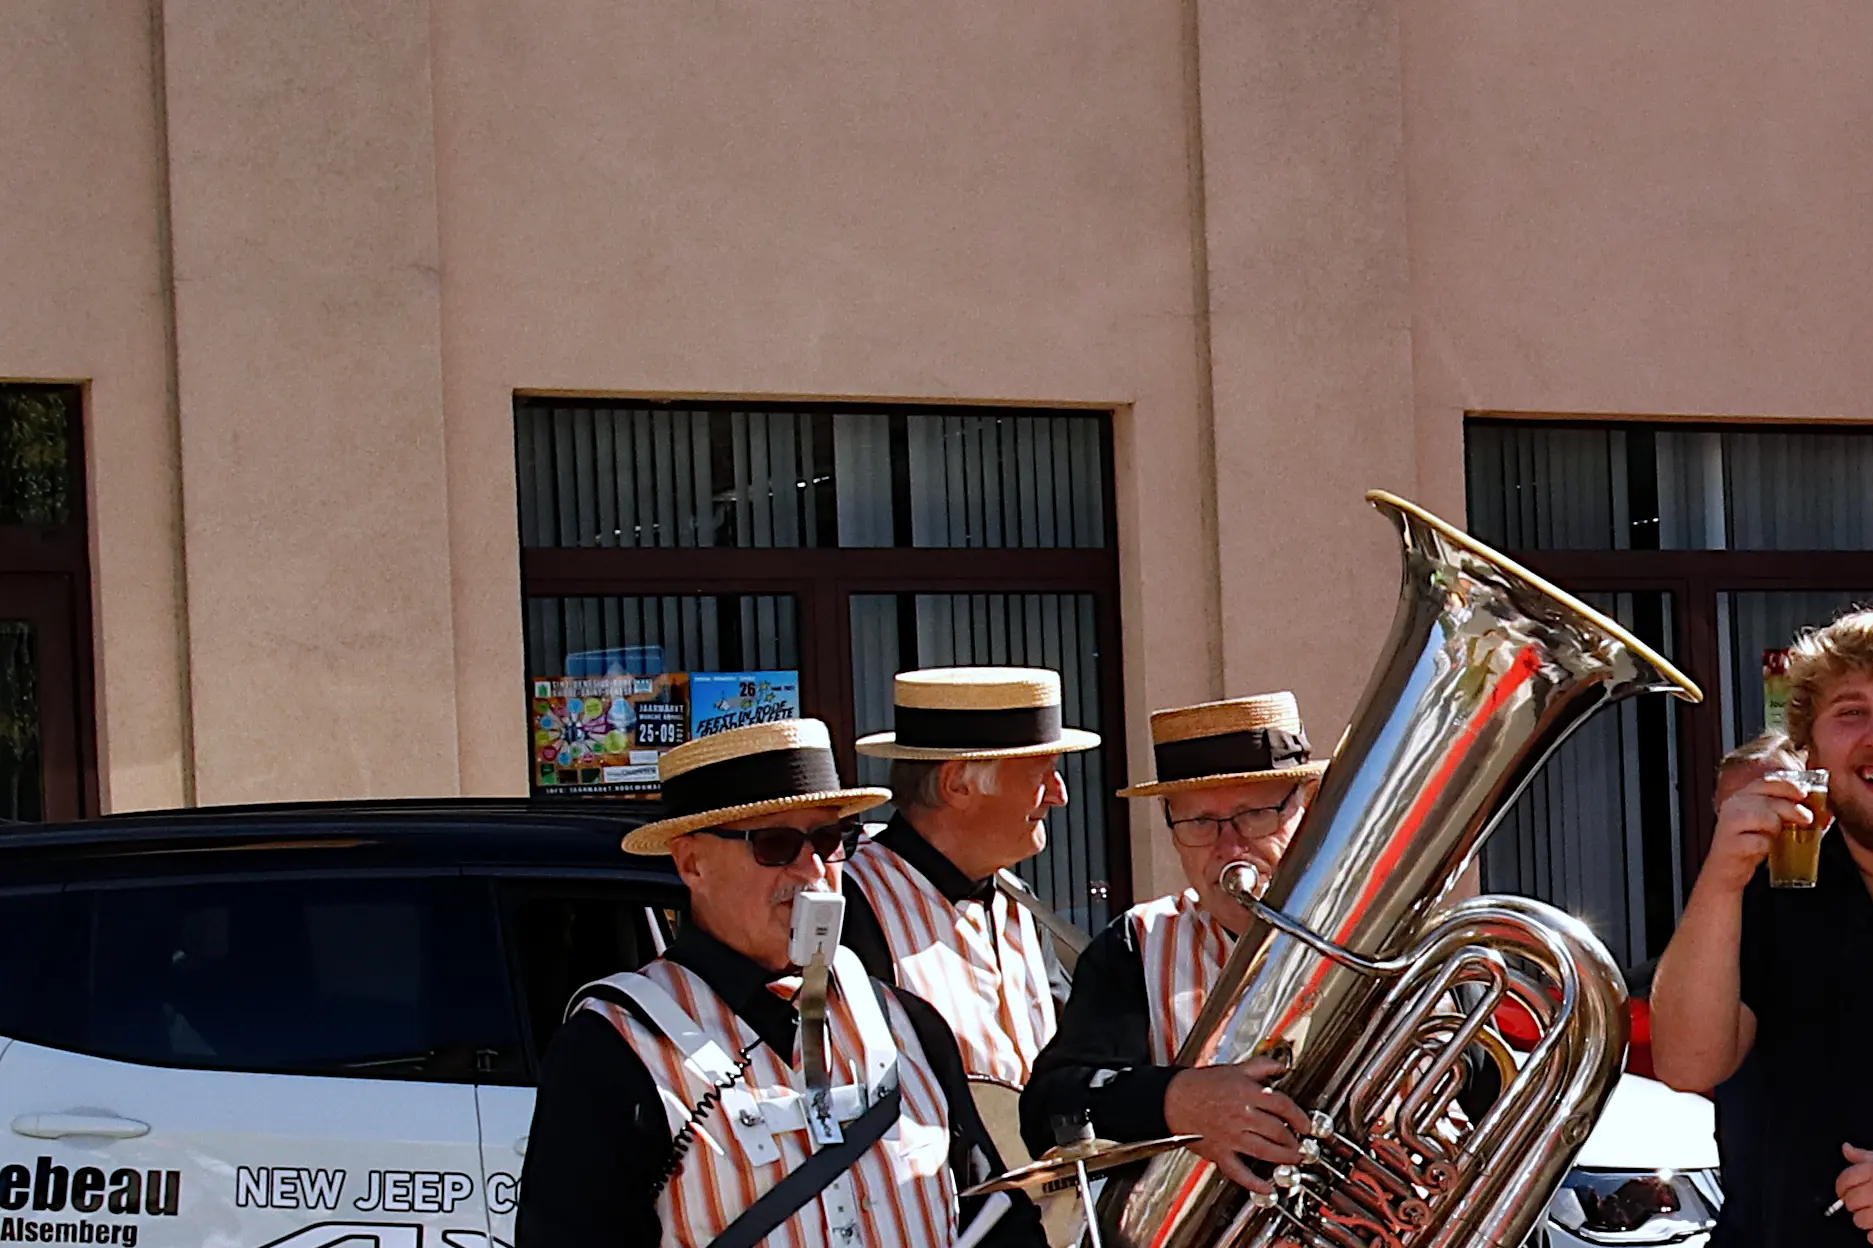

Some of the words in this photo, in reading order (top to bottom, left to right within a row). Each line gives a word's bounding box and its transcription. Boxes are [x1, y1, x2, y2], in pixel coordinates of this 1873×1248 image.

[740, 681, 756, 697] 26
[696, 712, 737, 733] FEEST
[755, 700, 787, 717] RODE
[236, 1166, 346, 1209] NEW
[354, 1171, 473, 1212] JEEP
[1, 1217, 138, 1248] Alsemberg
